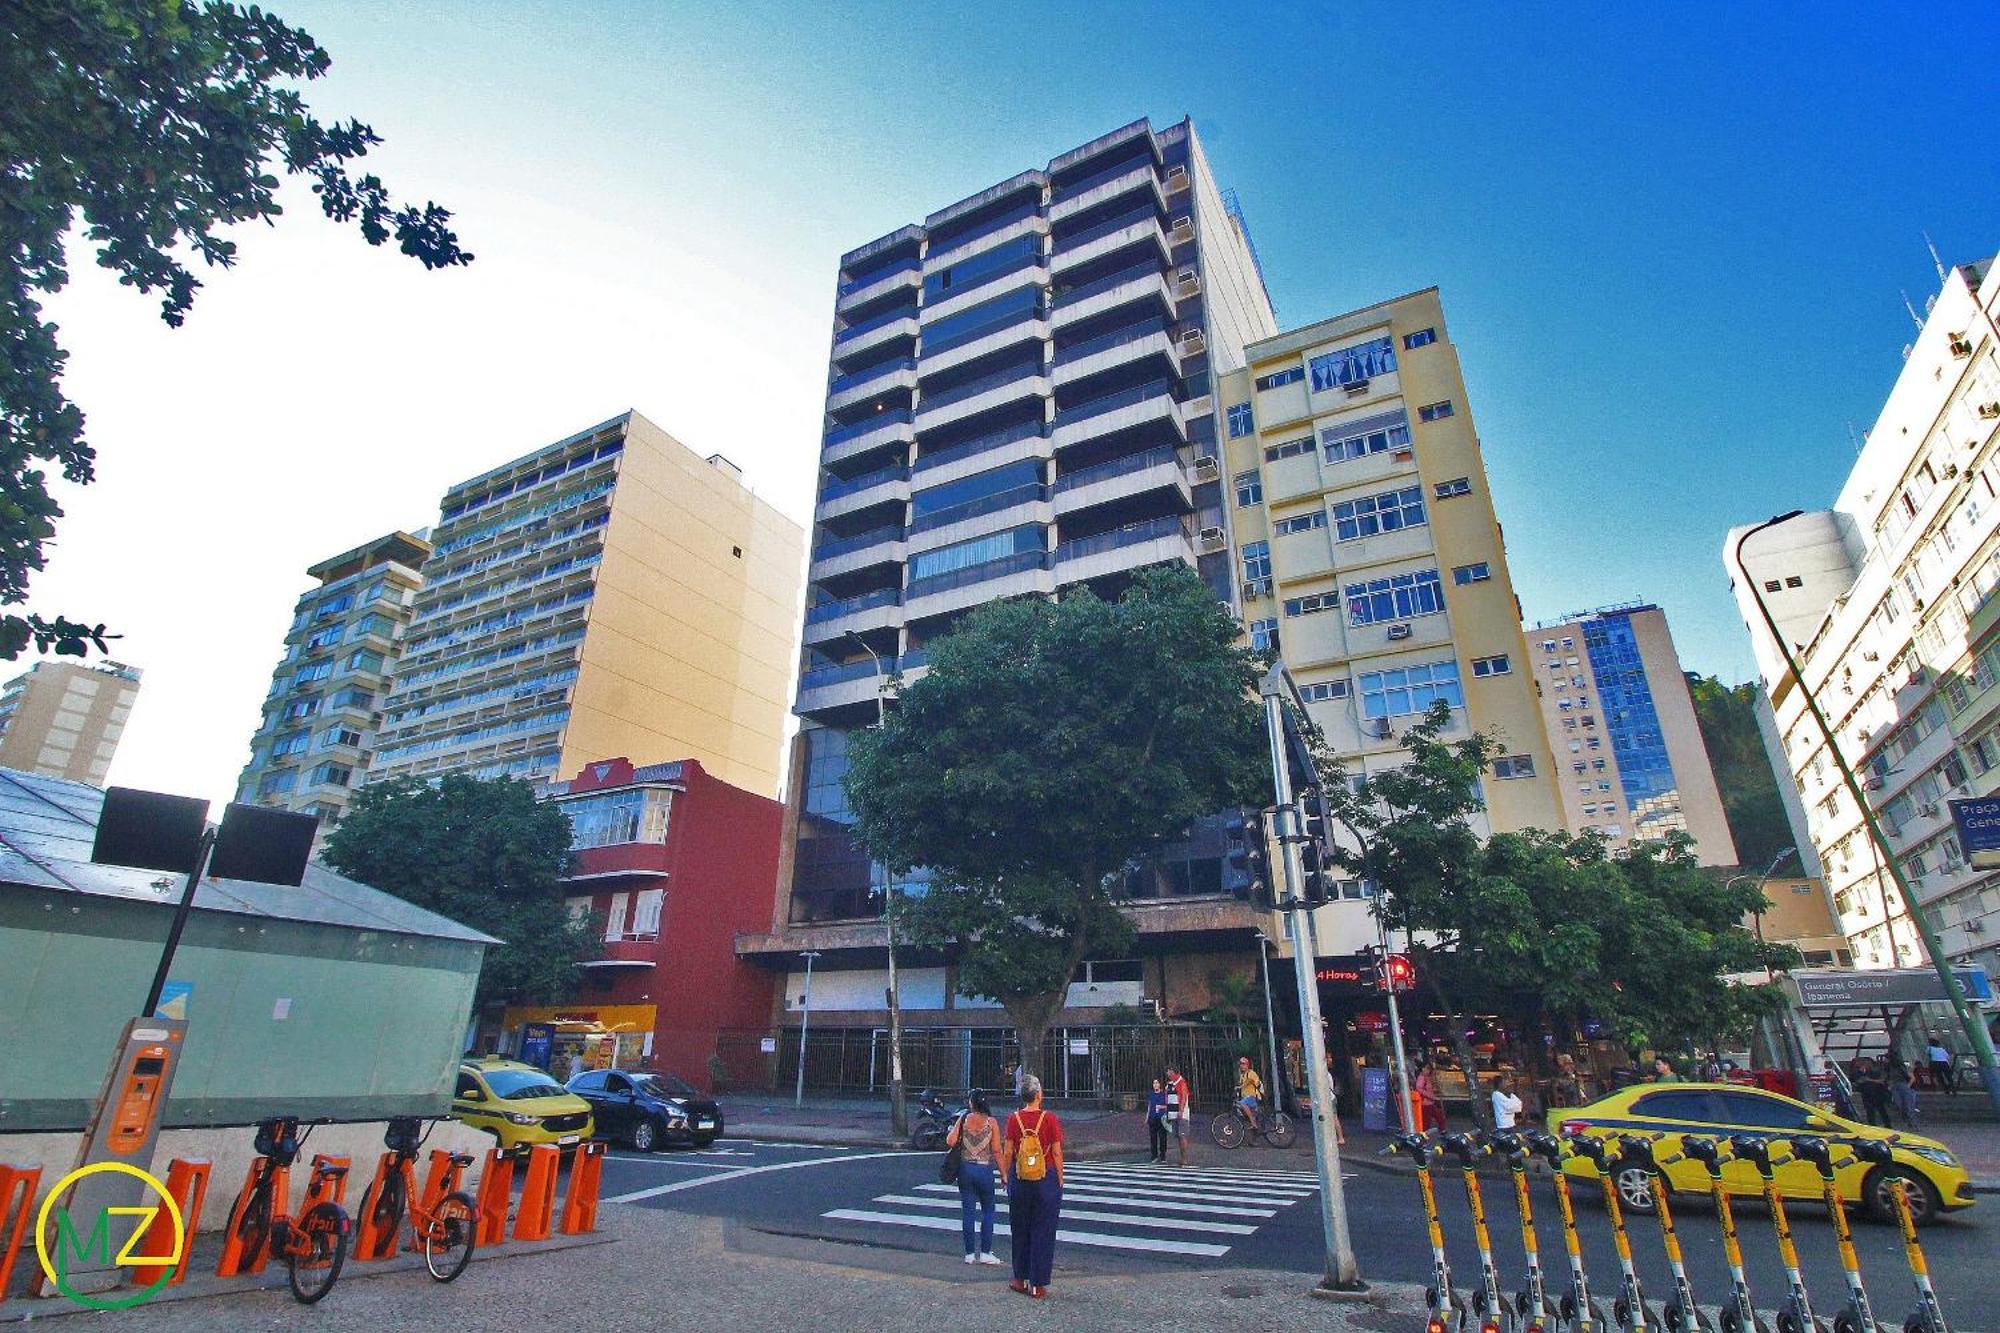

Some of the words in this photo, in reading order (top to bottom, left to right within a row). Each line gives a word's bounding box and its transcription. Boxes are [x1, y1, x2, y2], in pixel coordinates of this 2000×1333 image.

[1961, 803, 1999, 815] Praça
[1326, 969, 1359, 981] Horas
[1804, 980, 1845, 991] General
[1807, 991, 1851, 1001] Ipanema
